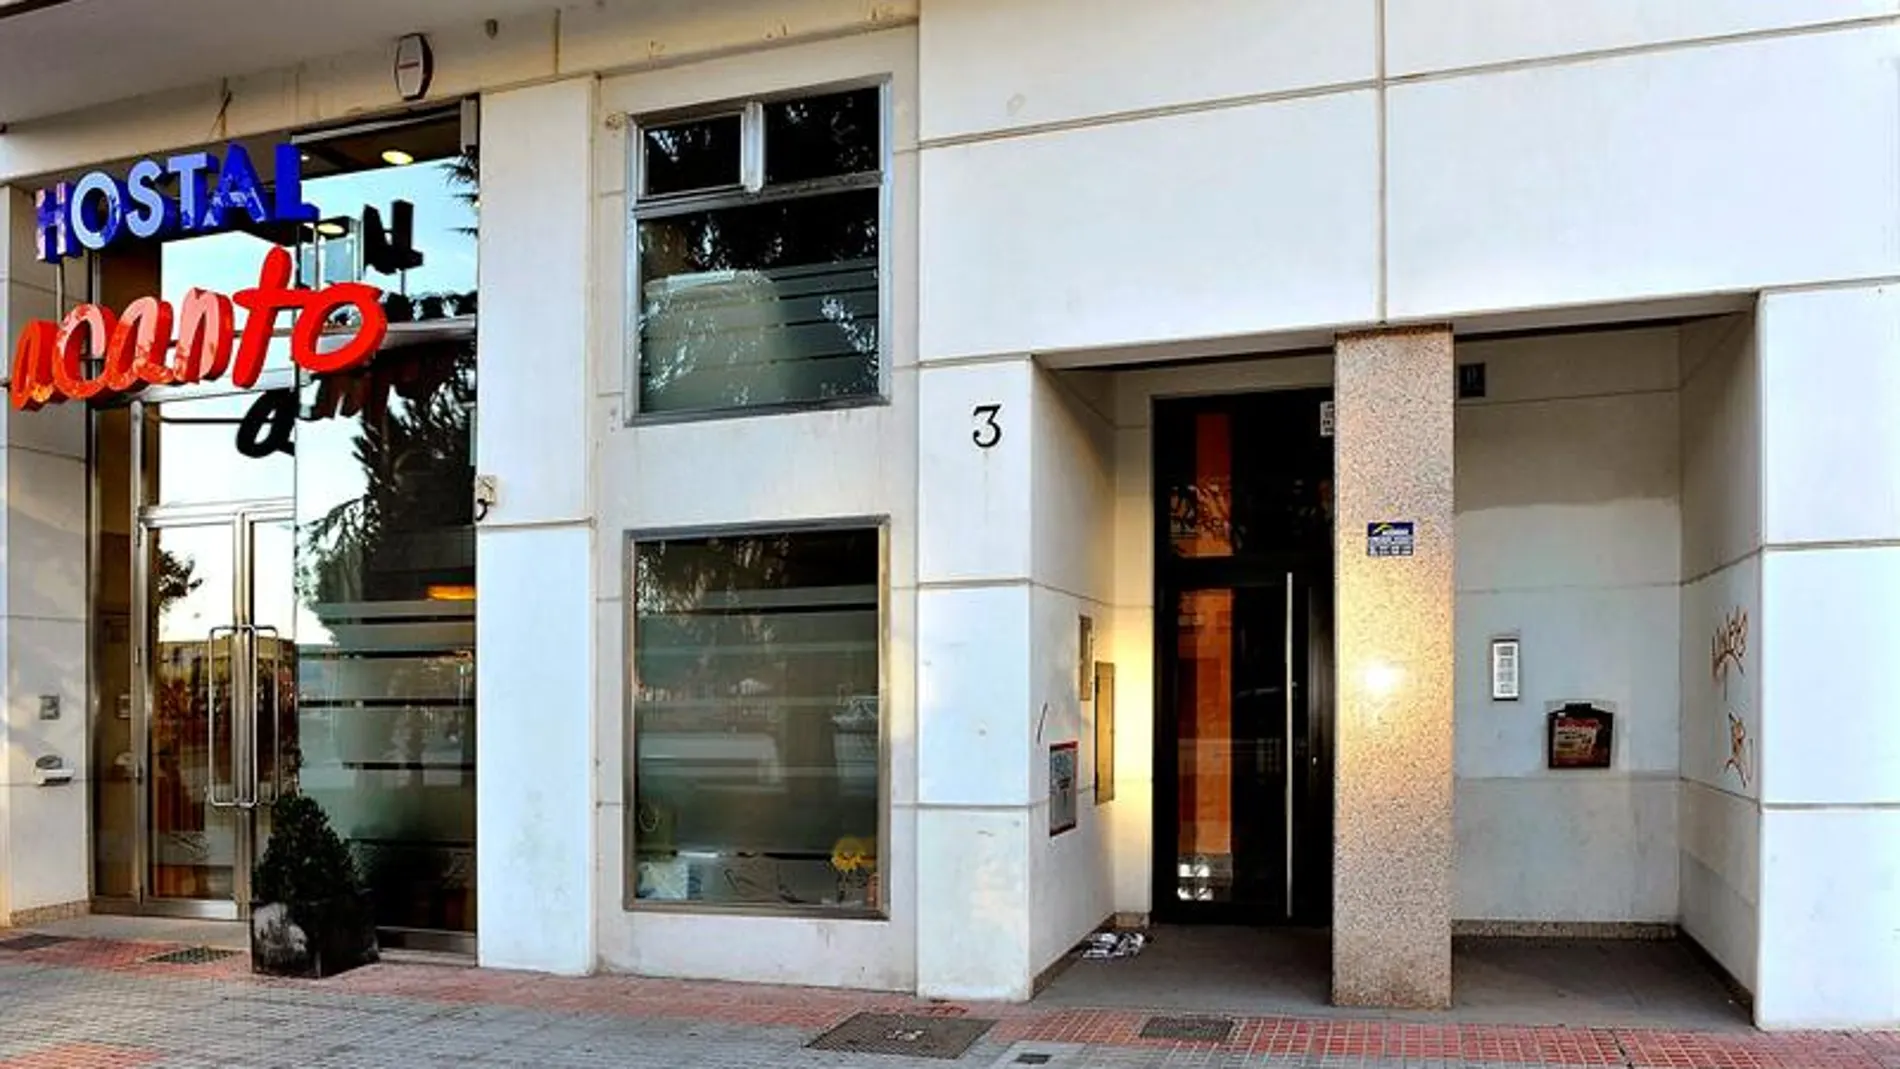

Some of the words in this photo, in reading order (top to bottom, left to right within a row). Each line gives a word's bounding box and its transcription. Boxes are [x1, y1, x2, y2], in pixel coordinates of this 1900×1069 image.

[35, 141, 319, 263] HOSTAL
[10, 246, 388, 411] acanto
[972, 404, 1002, 449] 3
